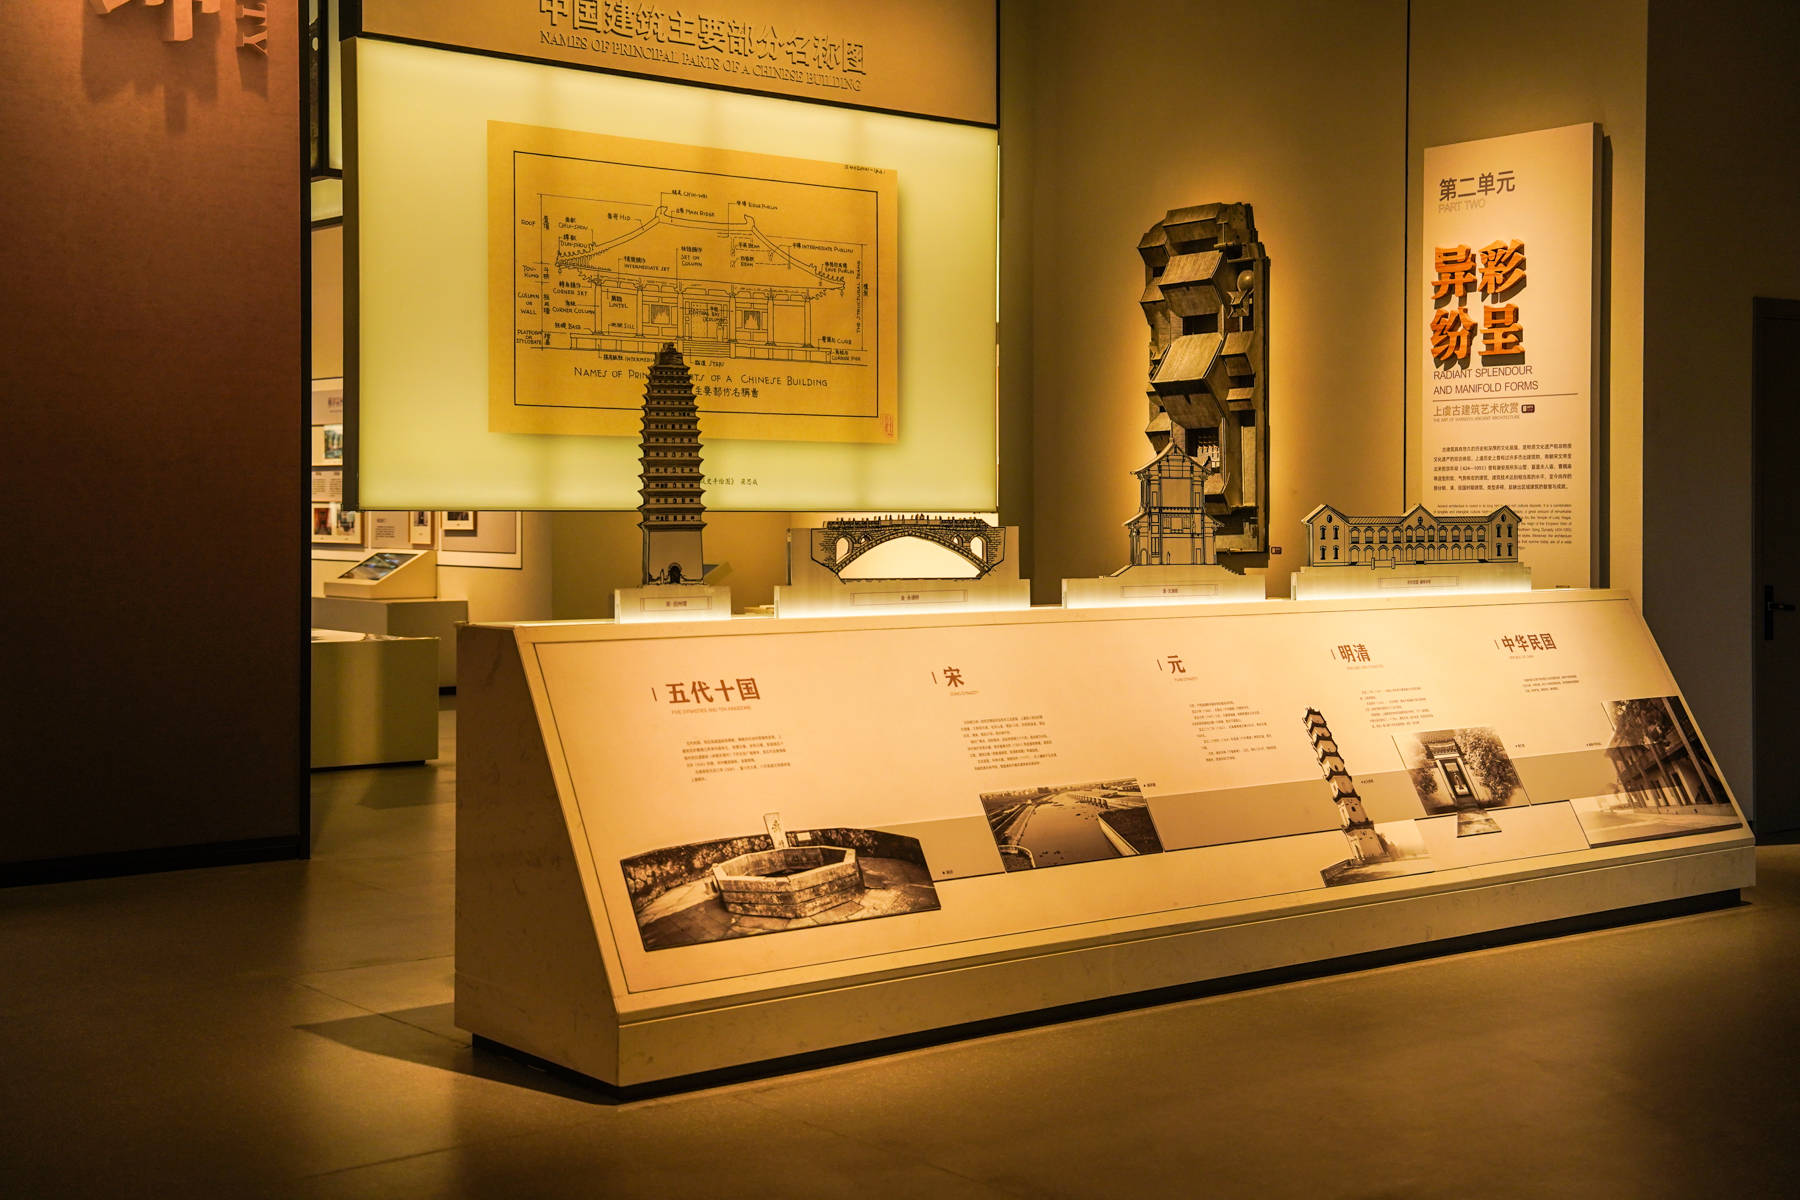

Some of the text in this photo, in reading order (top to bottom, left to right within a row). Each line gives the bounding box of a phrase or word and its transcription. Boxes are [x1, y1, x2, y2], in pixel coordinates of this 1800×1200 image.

[539, 30, 861, 92] NAMES OF PRINCIPAL PARTS OF A CHINESE BUILDING
[1440, 170, 1515, 201] 第二单元
[1438, 199, 1486, 214] PART TWO
[521, 219, 536, 227] ROOF
[1431, 239, 1526, 306] 异彩
[1430, 304, 1525, 367] 纷呈
[574, 367, 608, 378] NAMES
[612, 369, 623, 378] OF
[741, 374, 781, 385] CHINESE
[787, 376, 828, 387] BUILDING
[1433, 365, 1533, 380] RADIANT SPLENDOUR
[1433, 380, 1539, 395] AND MANIFOLD FORMS
[1433, 402, 1519, 417] 上虞古建筑艺术欣赏
[1501, 633, 1557, 652] 中华民国
[1338, 644, 1370, 662] 明清
[1167, 655, 1186, 674] 元
[944, 666, 965, 687] 宋
[665, 677, 761, 704] 五代十国
